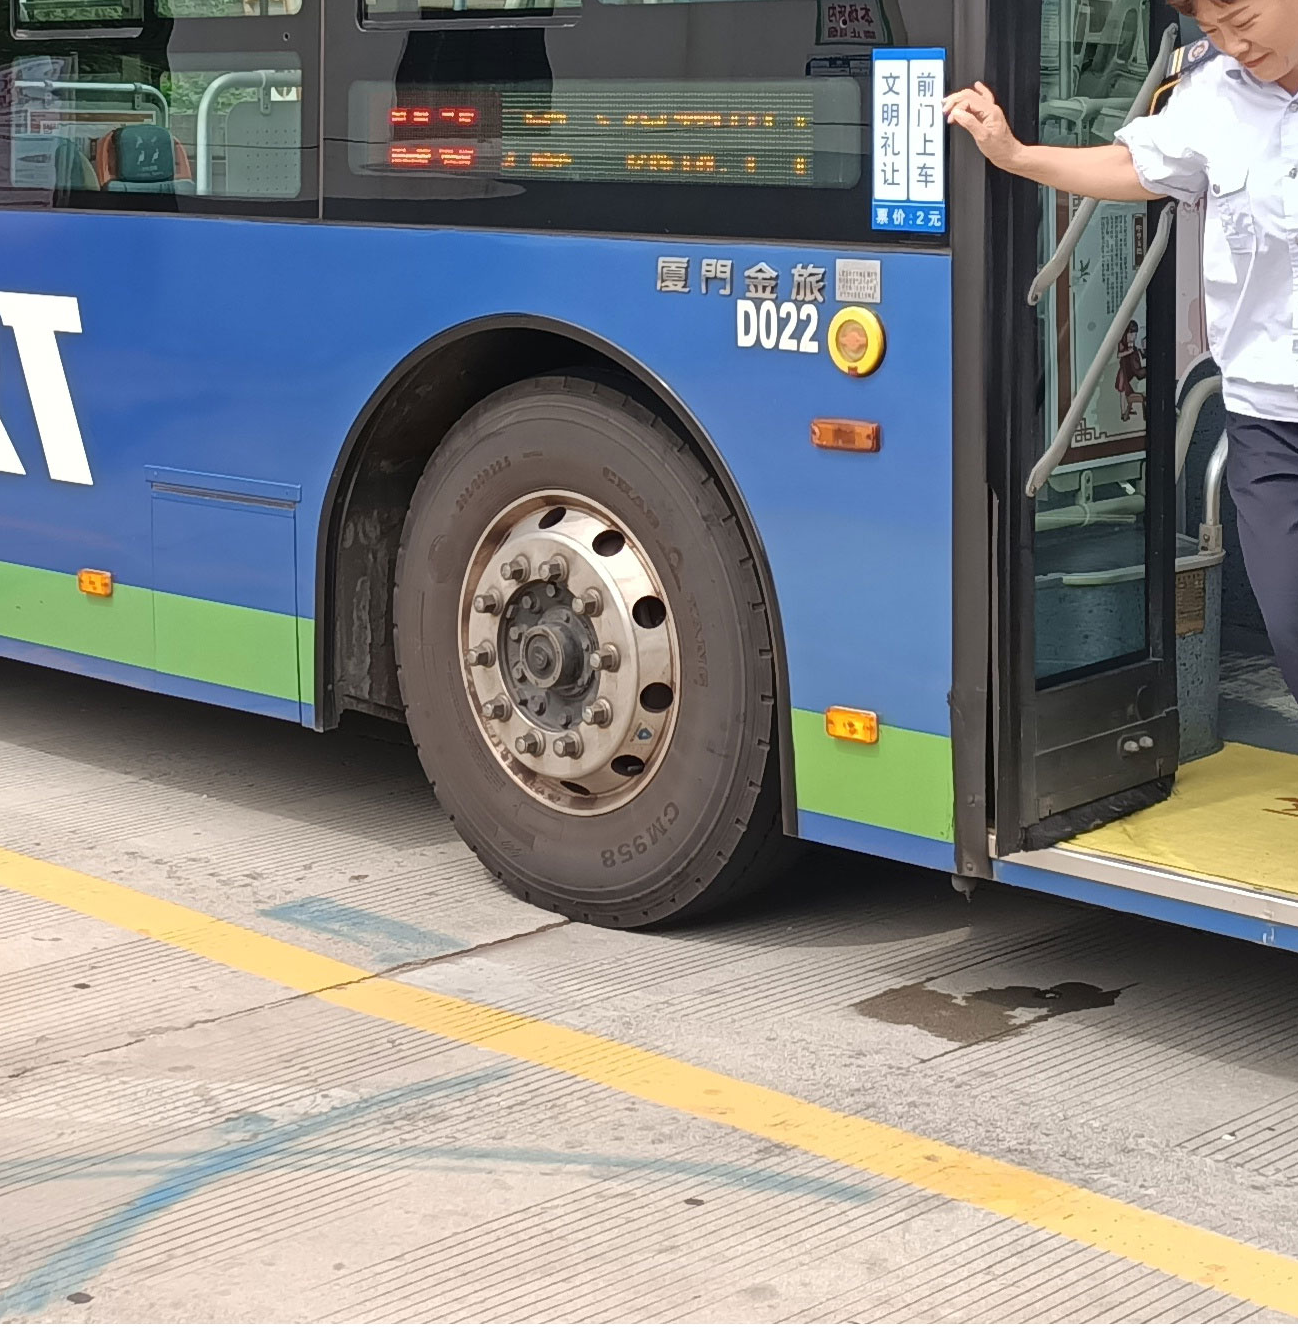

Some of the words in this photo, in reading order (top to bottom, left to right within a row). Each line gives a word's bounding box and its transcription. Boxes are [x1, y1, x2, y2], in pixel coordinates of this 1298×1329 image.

[880, 72, 901, 187] 文明礼让
[915, 72, 936, 188] 前门上车
[736, 298, 819, 354] D022
[600, 801, 680, 870] CM958
